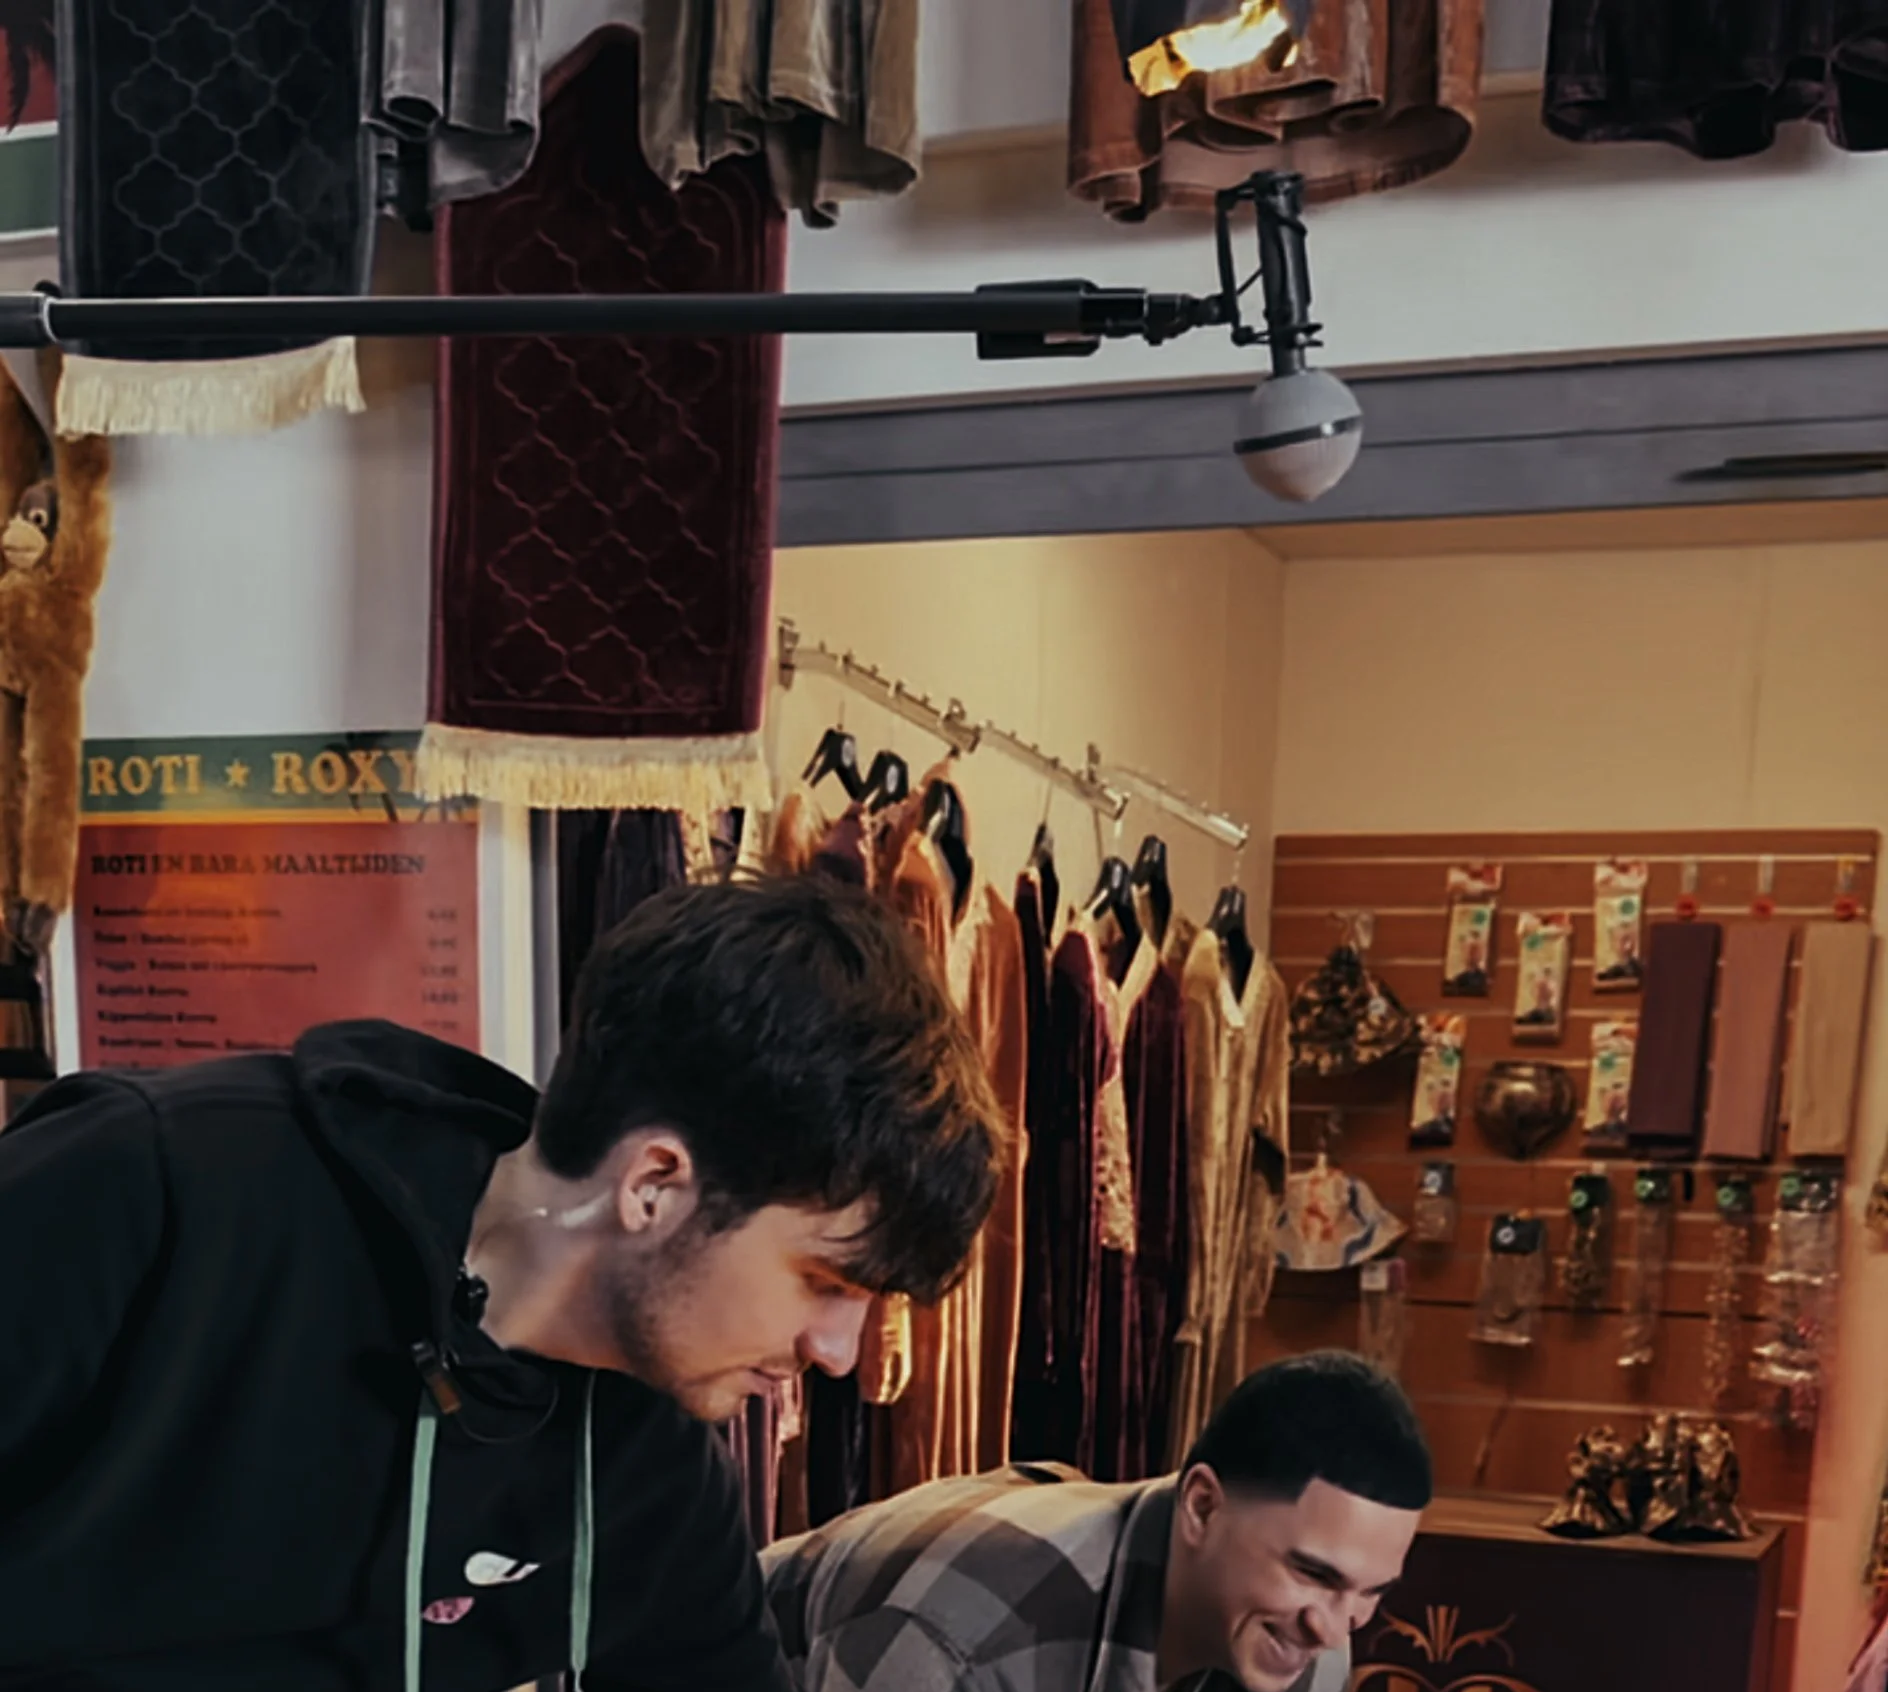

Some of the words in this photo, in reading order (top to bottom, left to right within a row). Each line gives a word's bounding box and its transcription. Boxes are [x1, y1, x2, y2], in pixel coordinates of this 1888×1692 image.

[87, 754, 201, 796] ROTI
[271, 750, 415, 796] ROXY
[92, 855, 146, 876] ROTI
[152, 855, 184, 875] EN
[189, 855, 257, 875] BARA
[263, 853, 426, 877] MAALTIJDEN
